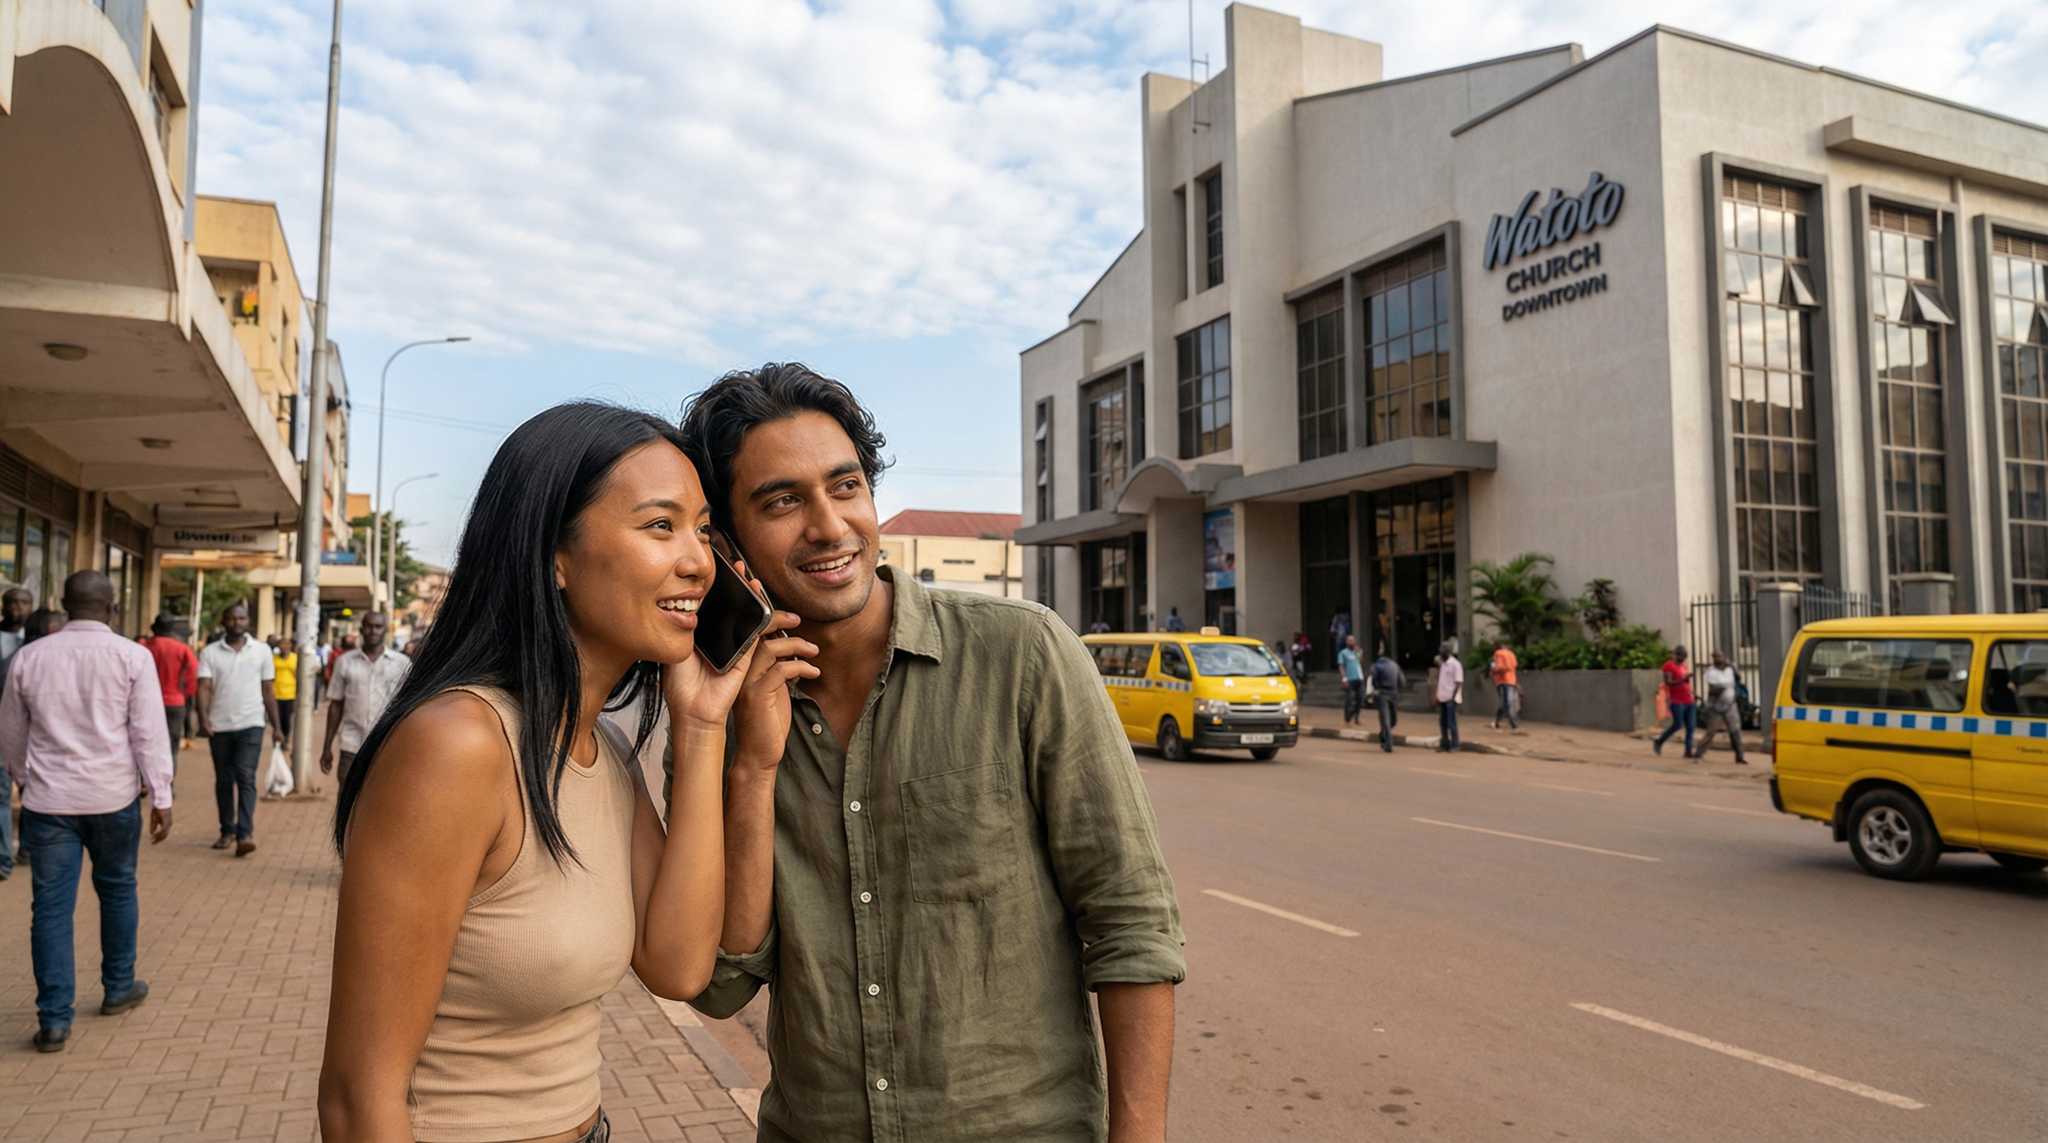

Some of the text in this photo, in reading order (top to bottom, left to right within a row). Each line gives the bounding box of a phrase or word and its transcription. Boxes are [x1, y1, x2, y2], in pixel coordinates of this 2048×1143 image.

[1483, 171, 1625, 271] Watoto
[1506, 242, 1601, 293] CHURCH
[1502, 273, 1608, 322] DOWNTOWN
